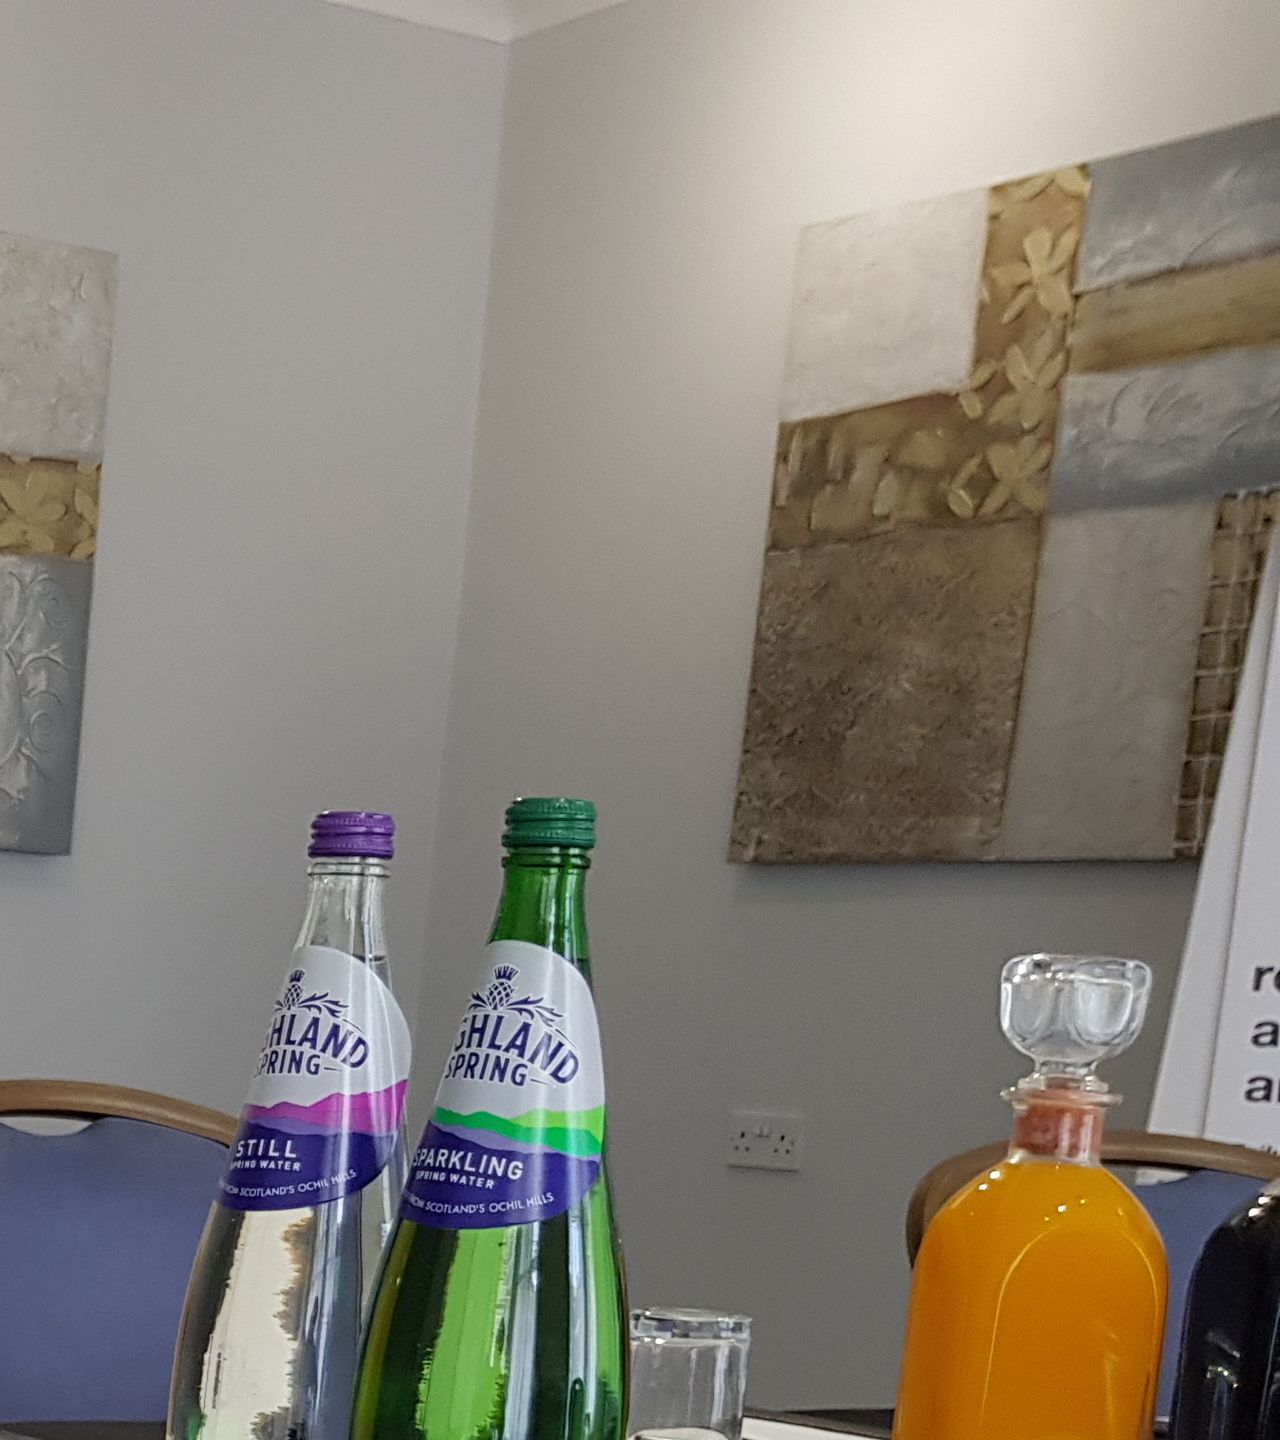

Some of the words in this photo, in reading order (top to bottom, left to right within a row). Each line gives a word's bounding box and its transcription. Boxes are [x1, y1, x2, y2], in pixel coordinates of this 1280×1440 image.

[1252, 965, 1280, 993] r
[264, 1013, 371, 1069] HLAND
[1244, 1075, 1280, 1103] a
[235, 1138, 297, 1158] STILL
[259, 1159, 301, 1172] WATER
[413, 1148, 524, 1181] SPARKLING
[239, 1185, 295, 1198] SCOTLAND'S
[297, 1178, 329, 1193] OCHIL
[449, 1173, 496, 1190] WATER
[425, 1201, 486, 1215] SCOTLAND'S
[488, 1199, 525, 1214] OCHIL
